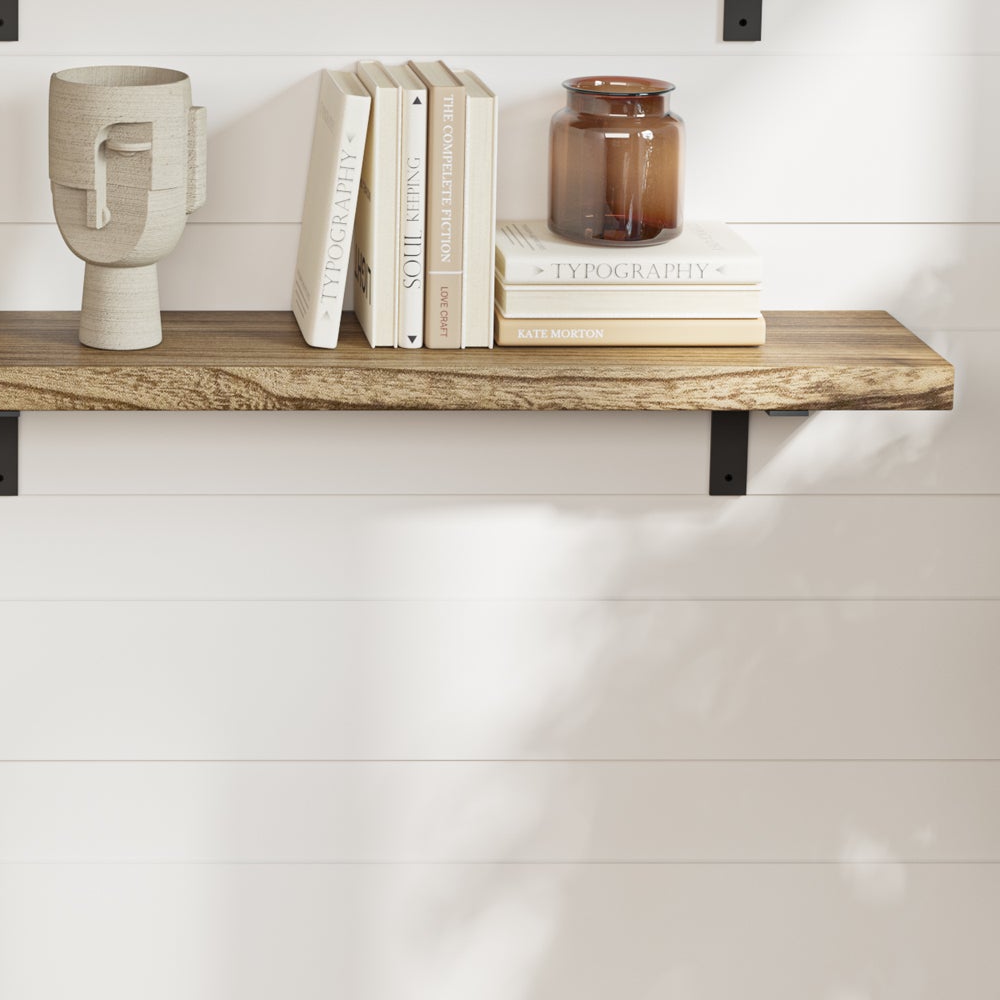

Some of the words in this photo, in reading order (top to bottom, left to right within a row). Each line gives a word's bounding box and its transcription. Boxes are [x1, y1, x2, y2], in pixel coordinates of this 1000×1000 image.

[442, 94, 454, 122] THE
[441, 125, 454, 206] COMPELETE
[406, 157, 421, 222] KEEPING
[320, 149, 357, 302] TYPOGRAPHY
[440, 209, 452, 263] FICTION
[550, 262, 711, 280] TYPOGRAPHY
[440, 286, 449, 308] LOVE
[439, 310, 448, 338] CRAFT
[517, 329, 548, 340] KATE
[550, 329, 604, 339] MORTON
